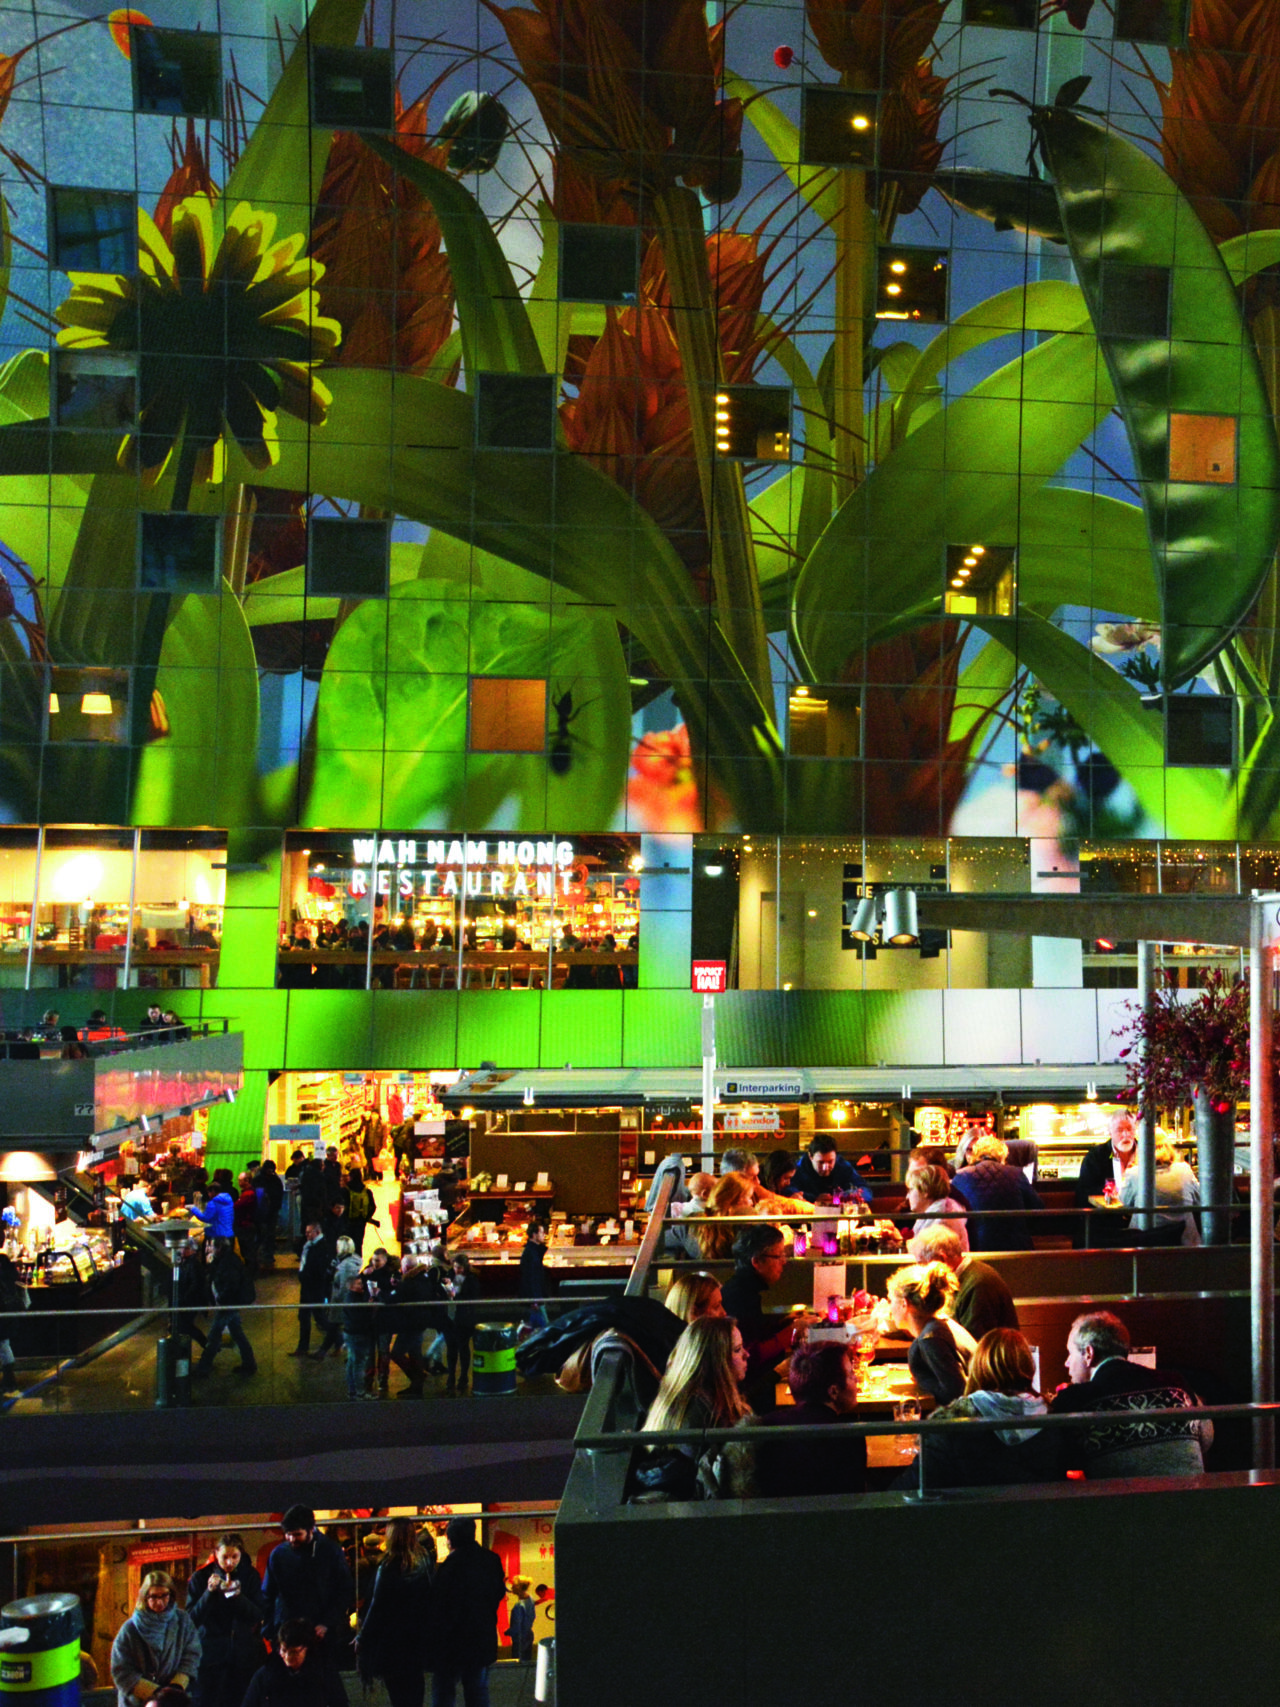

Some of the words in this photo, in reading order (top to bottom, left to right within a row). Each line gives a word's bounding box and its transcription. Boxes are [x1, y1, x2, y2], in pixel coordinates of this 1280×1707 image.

[353, 839, 416, 863] WAH
[427, 840, 487, 864] NAM
[498, 841, 574, 865] HONG
[352, 870, 573, 895] RESTAURANT
[856, 885, 873, 899] DE
[739, 1083, 801, 1093] Interparking
[76, 1104, 94, 1114] 77
[650, 1121, 724, 1140] FAMIY
